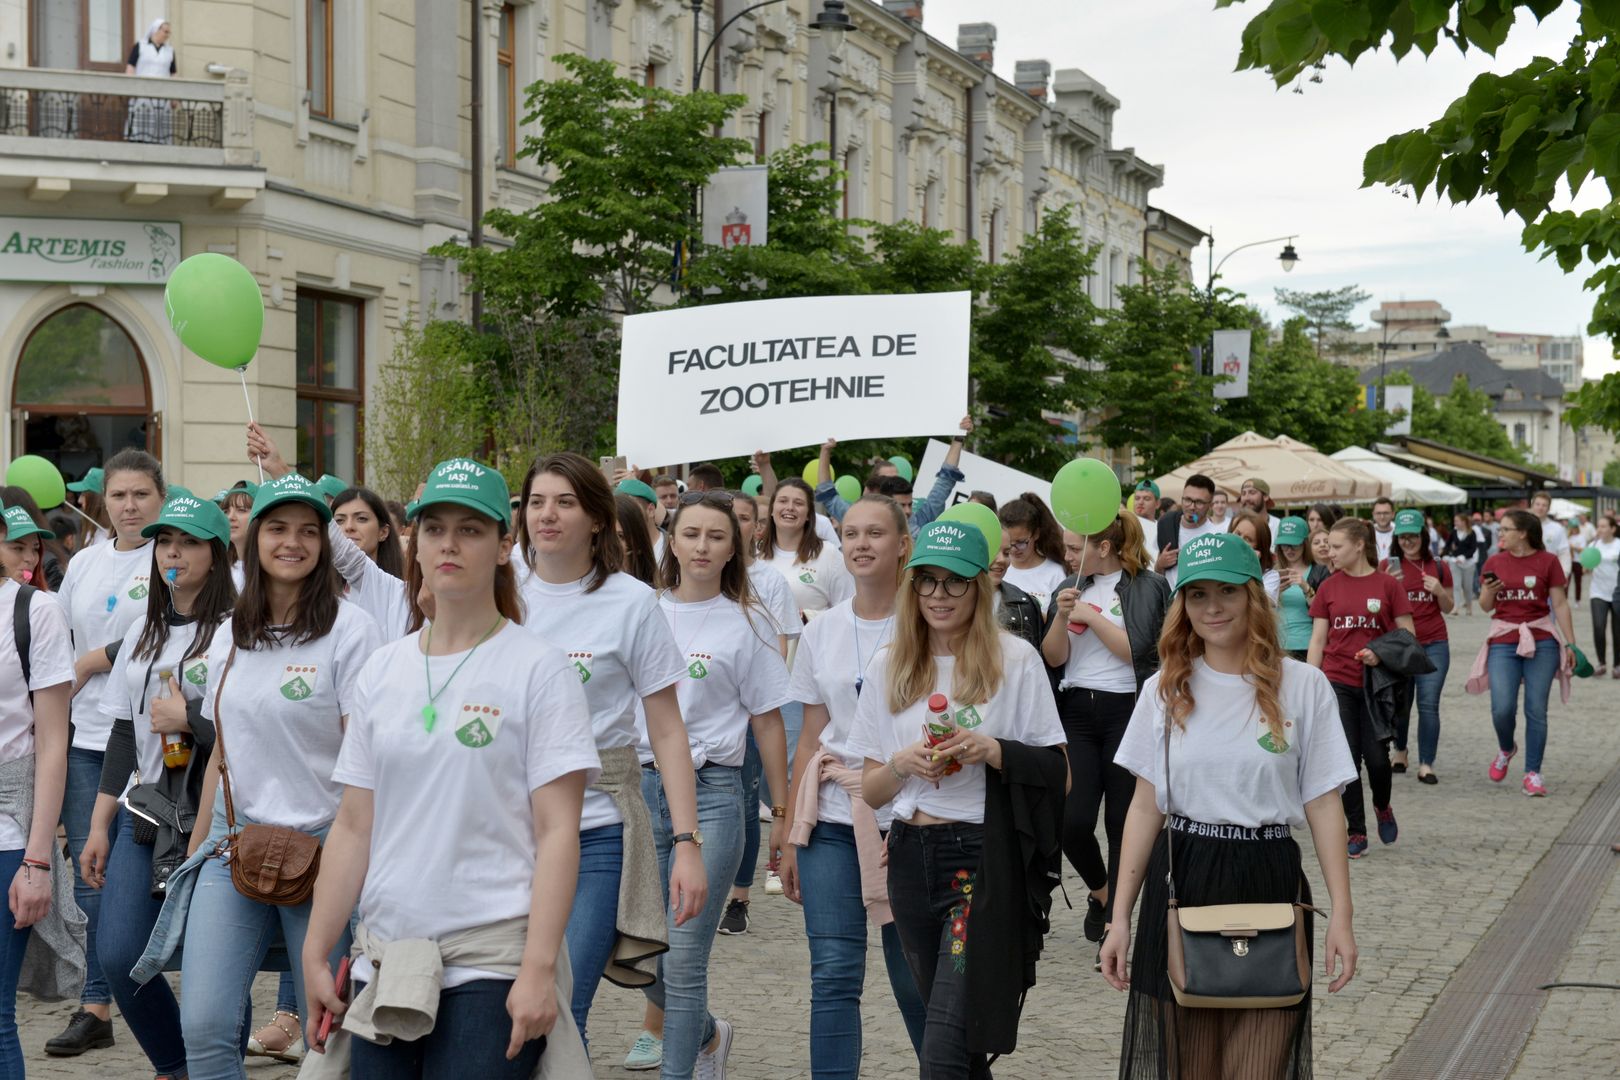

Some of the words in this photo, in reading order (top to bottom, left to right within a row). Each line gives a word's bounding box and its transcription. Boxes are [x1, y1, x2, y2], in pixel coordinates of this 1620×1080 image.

[668, 335, 861, 375] FACULTATEA
[872, 333, 917, 357] DE
[699, 375, 885, 415] ZOOTEHNIE
[437, 461, 486, 477] USAMV
[272, 474, 312, 488] USAMV
[168, 497, 201, 508] USAMV
[928, 525, 966, 540] USAMV
[1186, 537, 1225, 556] USAMV
[1496, 589, 1539, 601] C.E.P.A.
[1333, 615, 1380, 630] C.E.P.A.
[1187, 821, 1260, 841] #GIRLTALK
